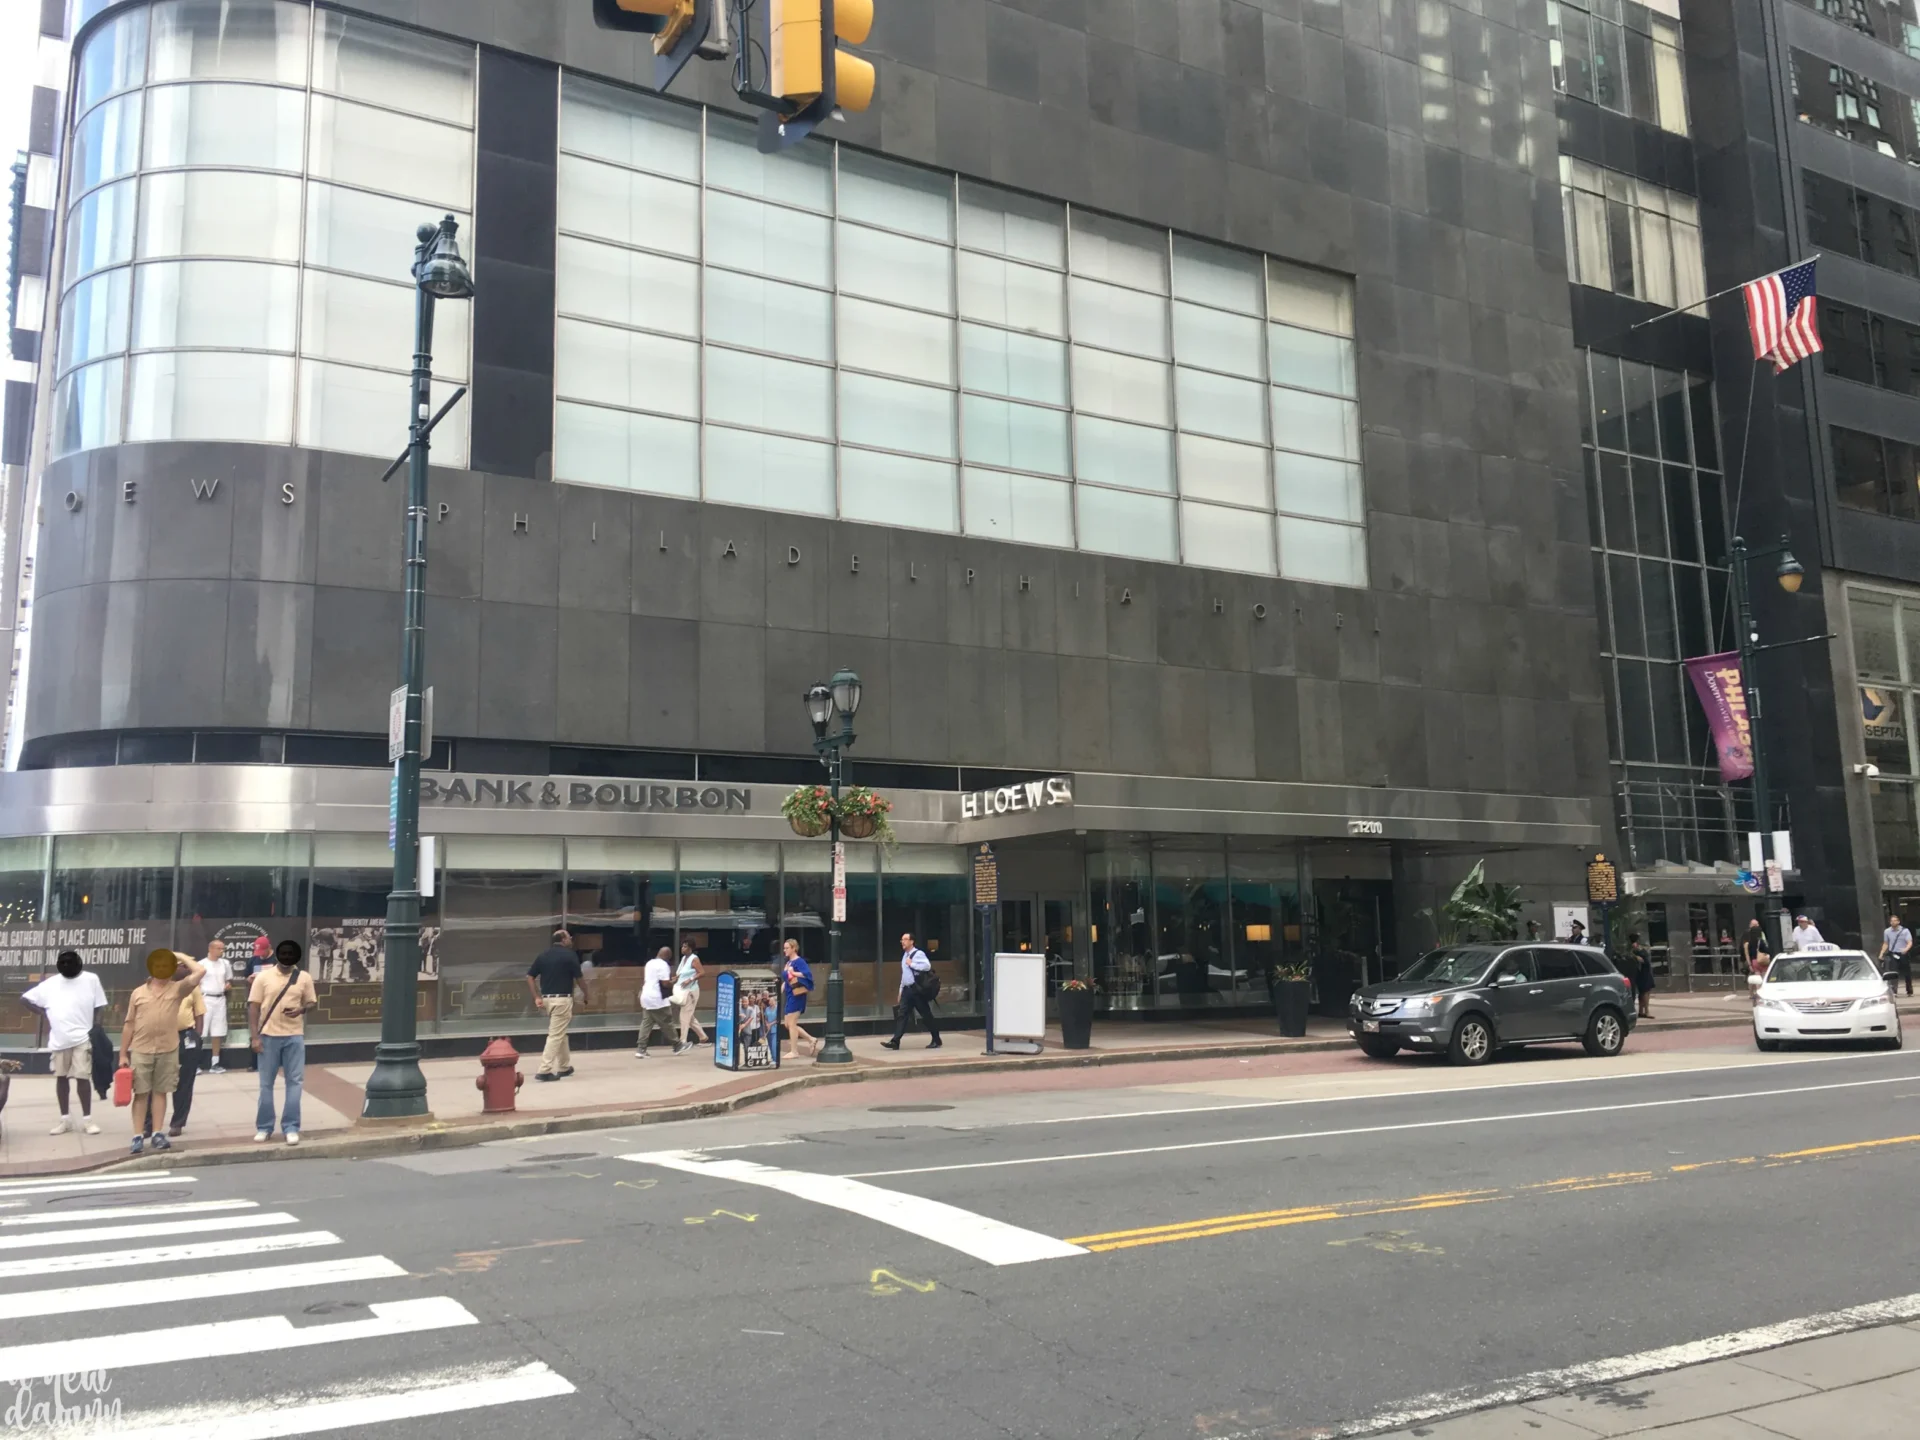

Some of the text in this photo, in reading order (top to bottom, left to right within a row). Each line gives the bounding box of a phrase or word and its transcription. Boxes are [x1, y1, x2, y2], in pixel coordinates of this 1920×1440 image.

[37, 477, 296, 526] OEWS
[436, 502, 1134, 604] PHILADELPHIA
[1865, 724, 1903, 738] SEPTA
[419, 777, 752, 811] BANK & BOURBON
[984, 777, 1060, 815] LOEWS
[58, 928, 86, 946] PLACE
[87, 928, 125, 946] DURING
[127, 927, 147, 945] THE
[73, 947, 131, 966] NVENTION!
[349, 997, 383, 1005] BURGE
